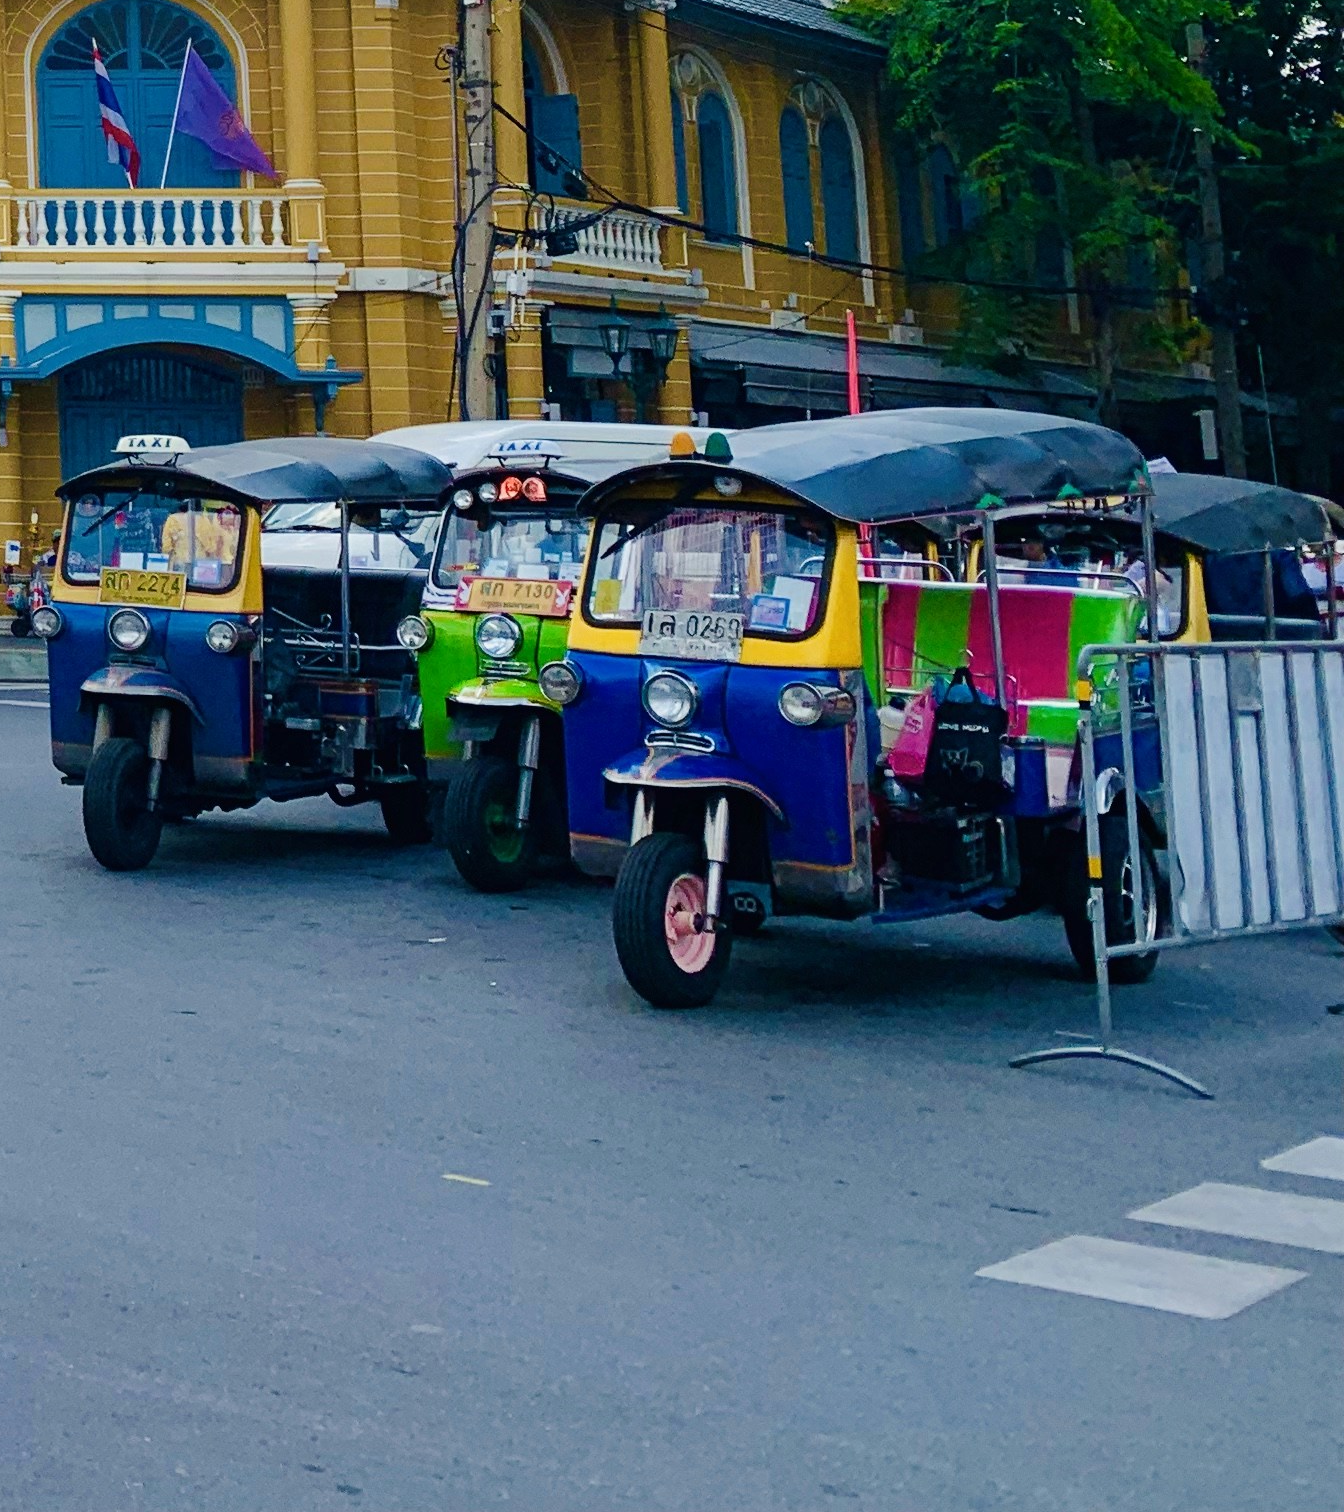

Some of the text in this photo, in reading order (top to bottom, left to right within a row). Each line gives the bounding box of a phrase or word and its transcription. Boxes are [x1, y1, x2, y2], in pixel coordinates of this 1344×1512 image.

[127, 437, 173, 448] TAXI
[498, 440, 543, 452] TAXI
[136, 573, 181, 595] 2274
[512, 582, 554, 600] 7130
